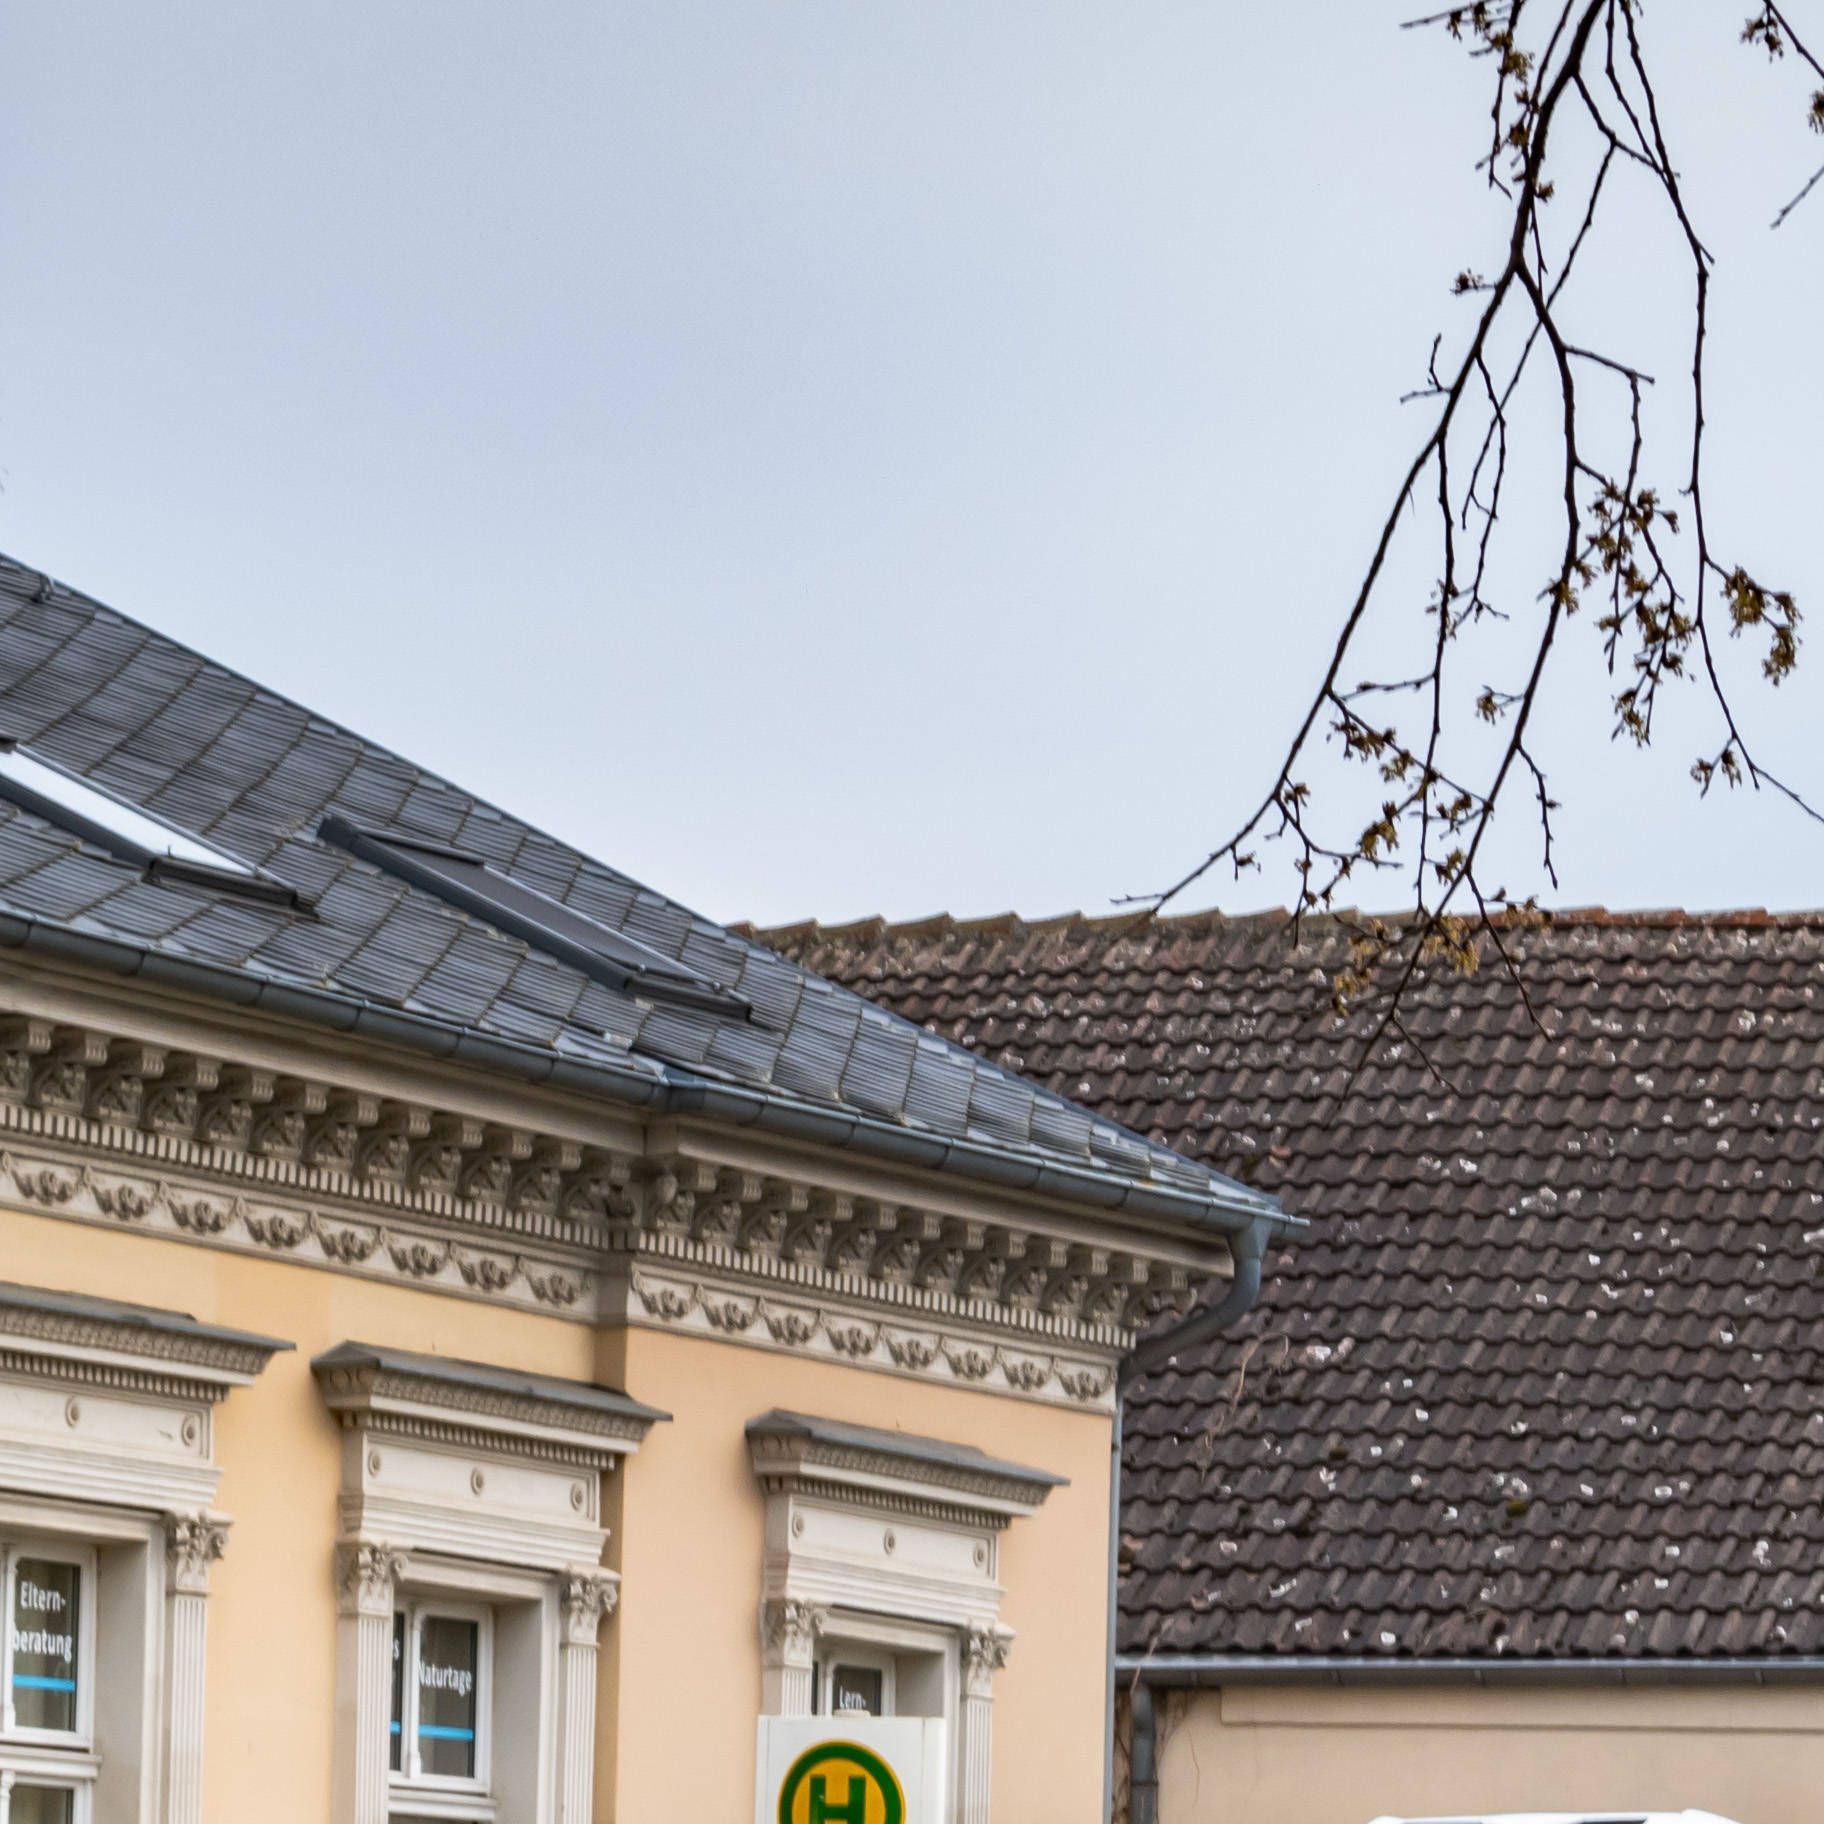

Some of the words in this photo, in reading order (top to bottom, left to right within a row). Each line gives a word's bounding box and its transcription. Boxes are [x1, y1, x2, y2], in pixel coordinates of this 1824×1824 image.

[20, 1580, 66, 1613] Eltern-
[13, 1628, 72, 1664] beratung
[417, 1656, 473, 1697] Naturtage
